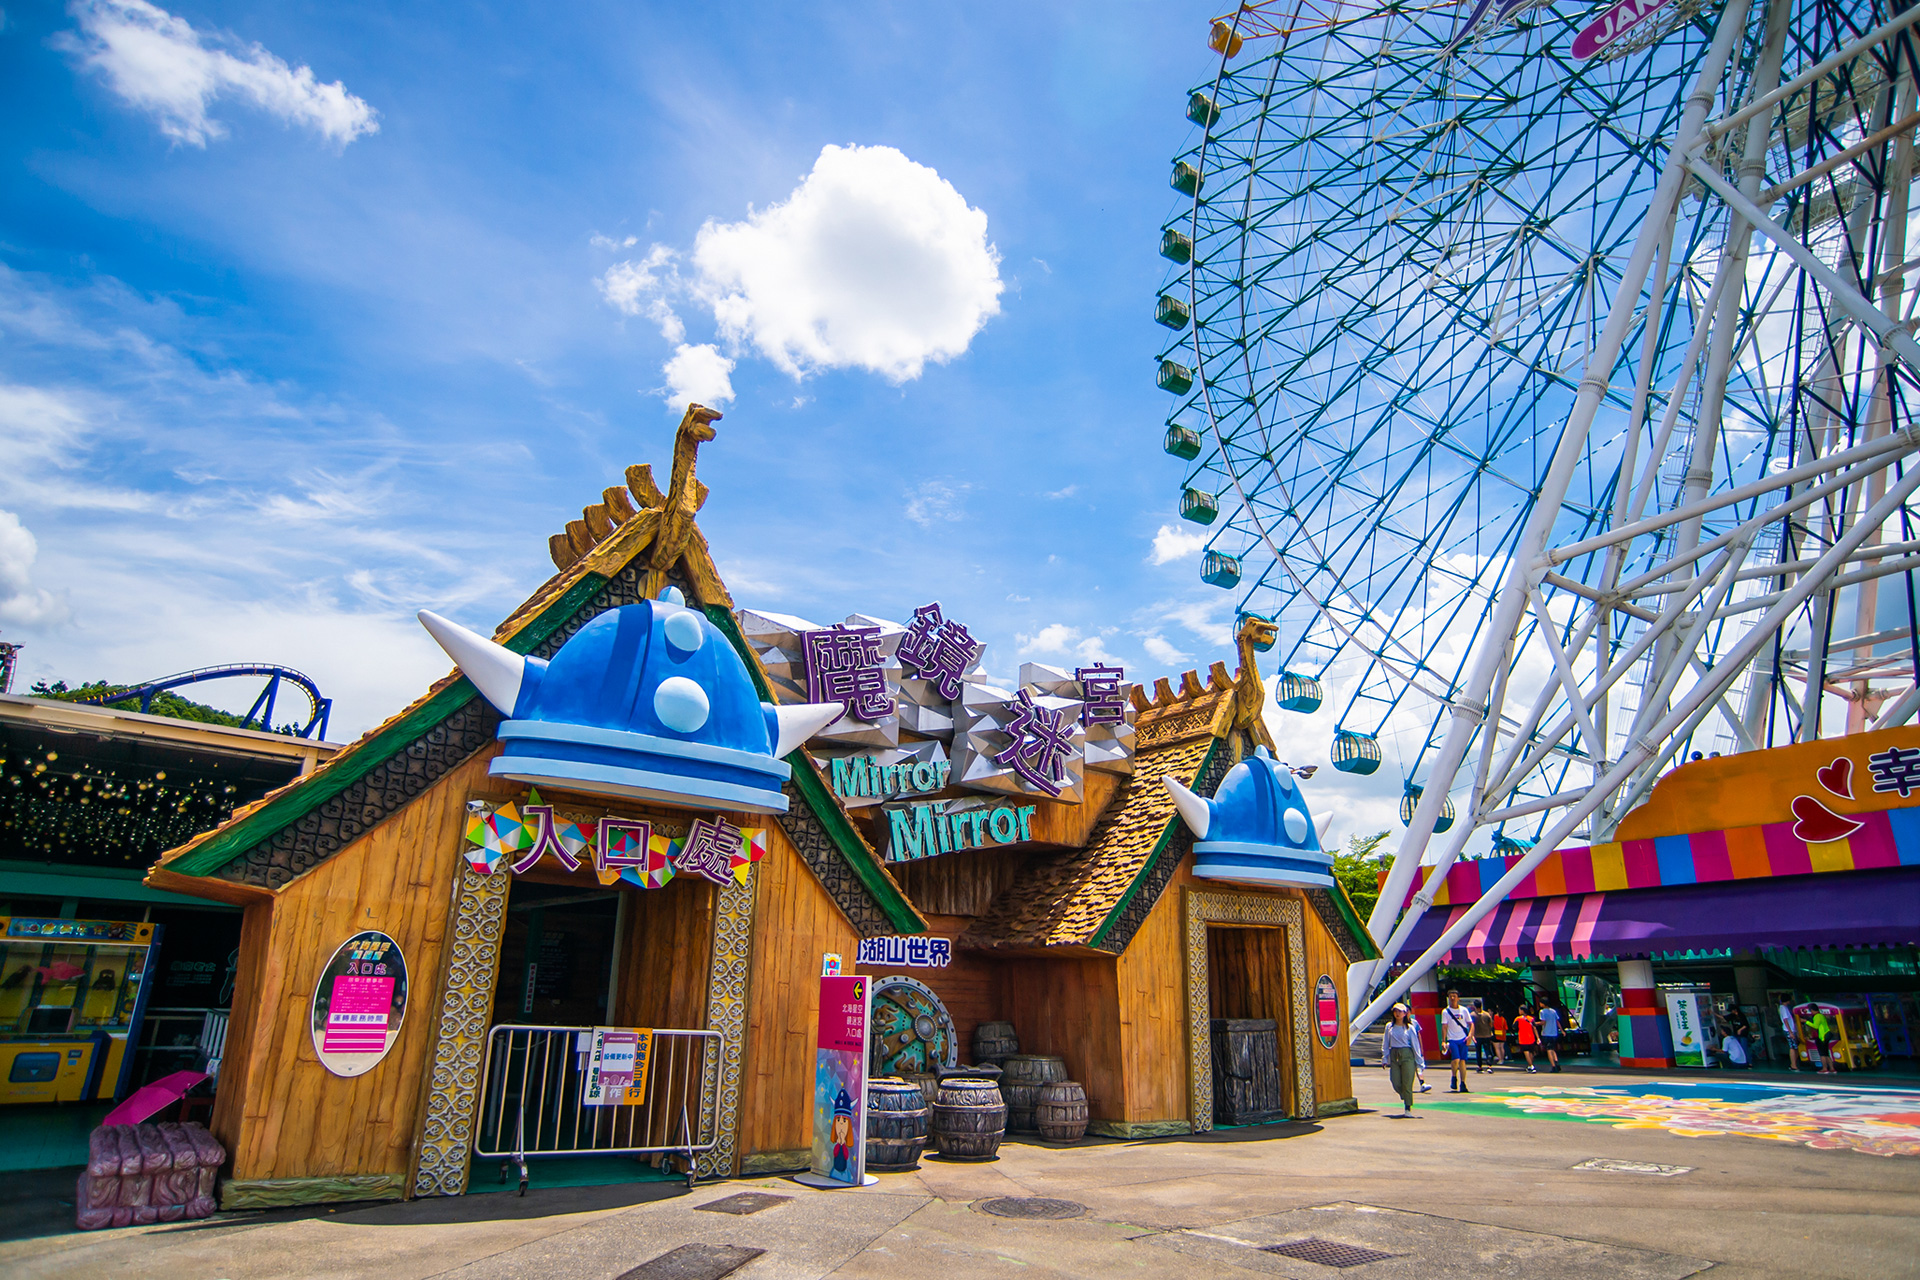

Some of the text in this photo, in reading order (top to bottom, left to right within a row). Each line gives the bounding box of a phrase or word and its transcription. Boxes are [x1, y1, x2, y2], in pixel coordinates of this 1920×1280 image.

[831, 755, 952, 798] Mirror
[1868, 747, 1920, 798] 幸
[509, 804, 744, 887] 入口處
[888, 803, 1037, 862] Mirror
[347, 962, 387, 975] 入口處
[857, 935, 951, 967] 湖山世界
[846, 1028, 862, 1038] 入口處
